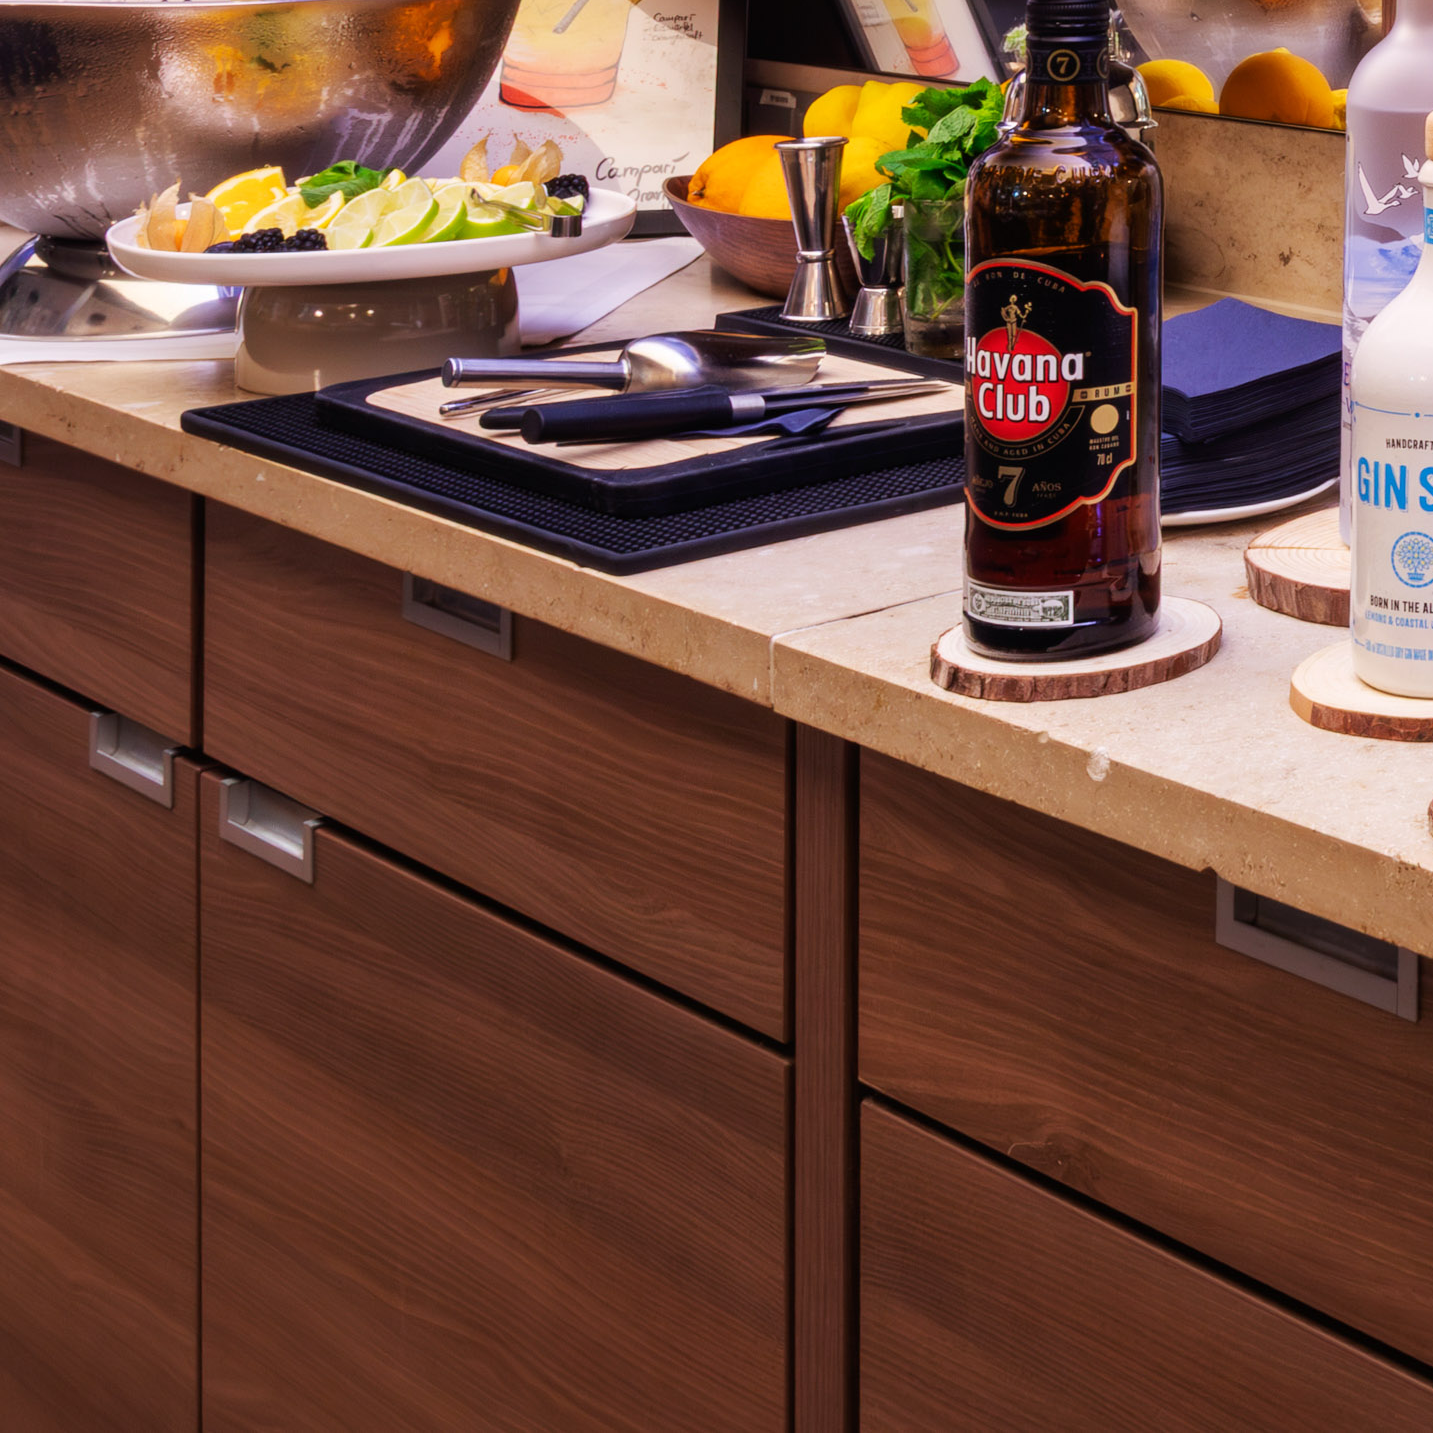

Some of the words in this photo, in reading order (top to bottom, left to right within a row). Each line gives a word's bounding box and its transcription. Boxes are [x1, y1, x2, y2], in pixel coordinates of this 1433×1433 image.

[1055, 57, 1071, 74] 7
[595, 151, 690, 187] Campari
[1037, 276, 1066, 294] CUBA
[966, 336, 1085, 382] Havana
[978, 382, 1051, 423] Club
[1095, 386, 1120, 399] RUM
[1003, 448, 1028, 457] AGED
[1033, 443, 1045, 453] IN
[1047, 423, 1071, 445] CUBA
[998, 465, 1026, 507] 7
[1032, 478, 1062, 493] AÑOS
[1358, 456, 1408, 511] GIN
[1370, 594, 1388, 610] BORN
[1390, 600, 1400, 612] IN
[1402, 601, 1420, 614] THE
[1395, 619, 1429, 630] COASTAL
